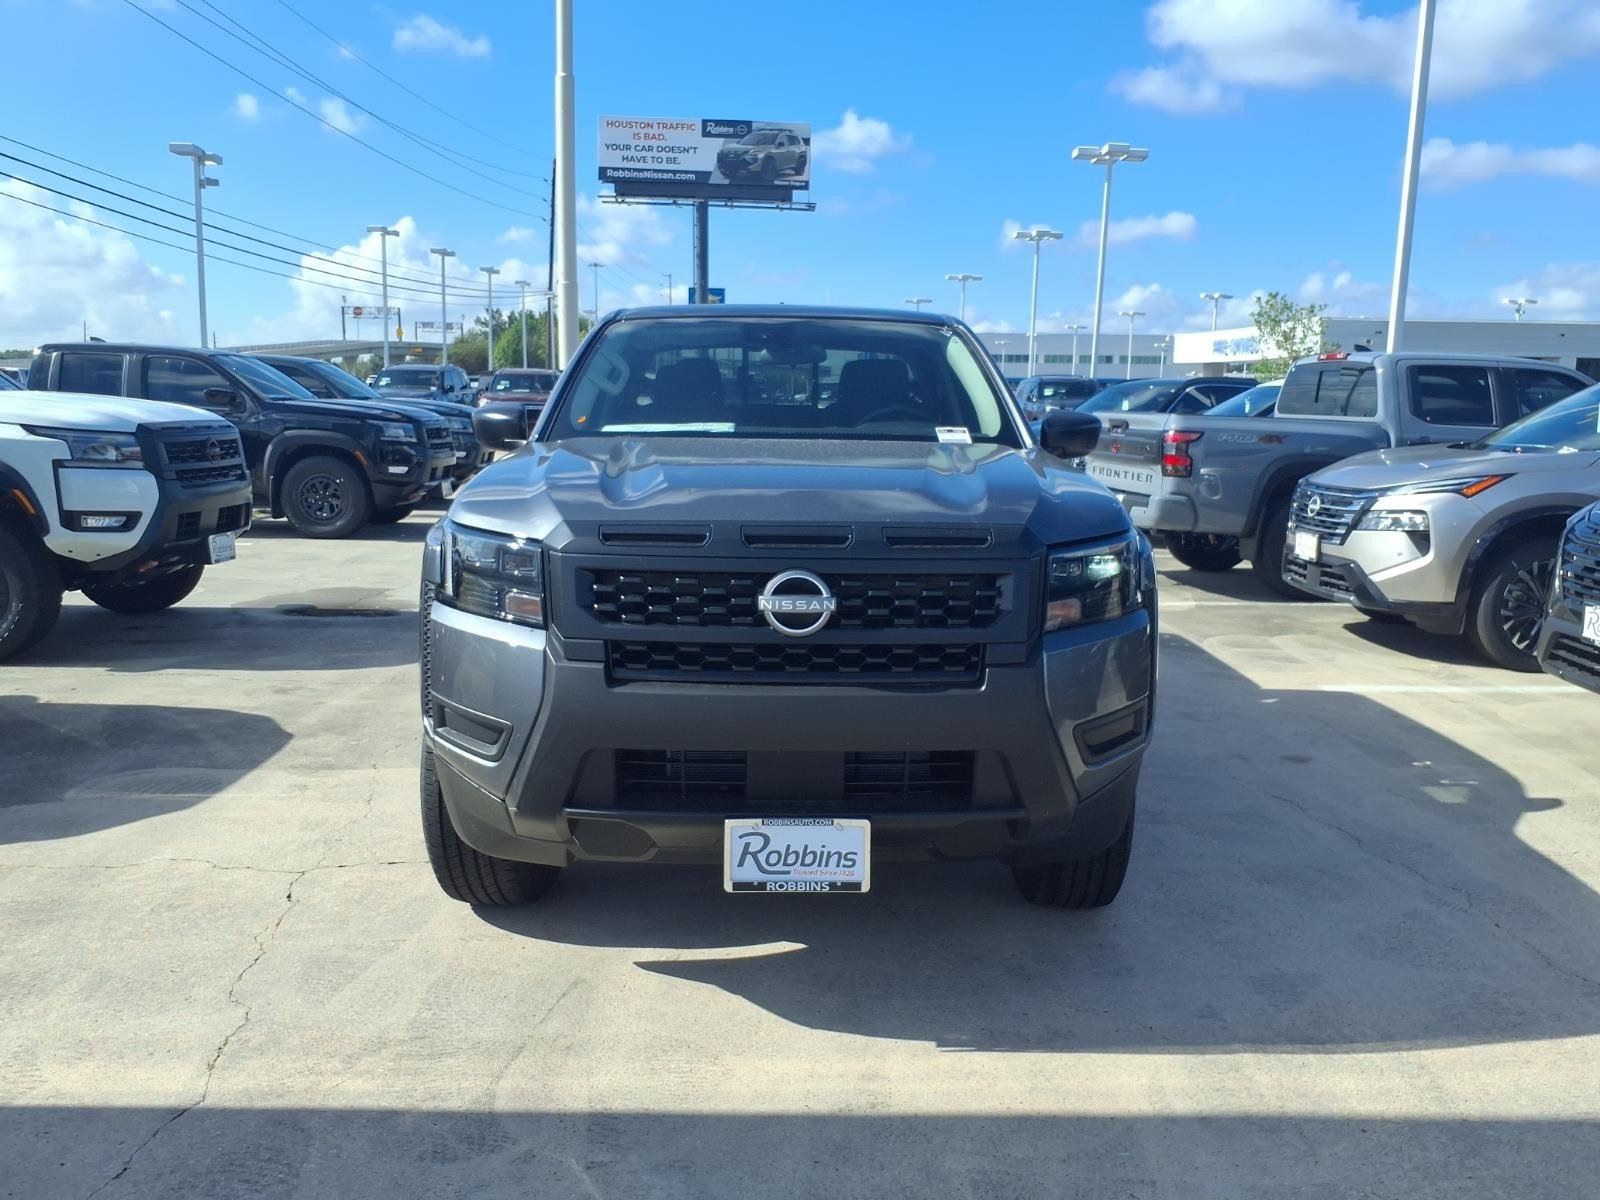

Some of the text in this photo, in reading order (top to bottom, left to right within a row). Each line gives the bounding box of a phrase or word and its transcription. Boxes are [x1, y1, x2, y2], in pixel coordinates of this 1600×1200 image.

[606, 120, 696, 132] HOUSTON TRAFFIC
[706, 122, 734, 135] Robbins
[633, 133, 668, 142] IS BAD.
[605, 144, 699, 154] YOUR CAR DOESN'T
[622, 156, 681, 165] HAVE TO BE.
[606, 169, 696, 181] RobbinsNissan.com
[1092, 465, 1153, 484] FRONTIER
[760, 599, 835, 610] NISSAN
[736, 831, 858, 875] Robbins
[766, 881, 830, 892] ROBBINS
